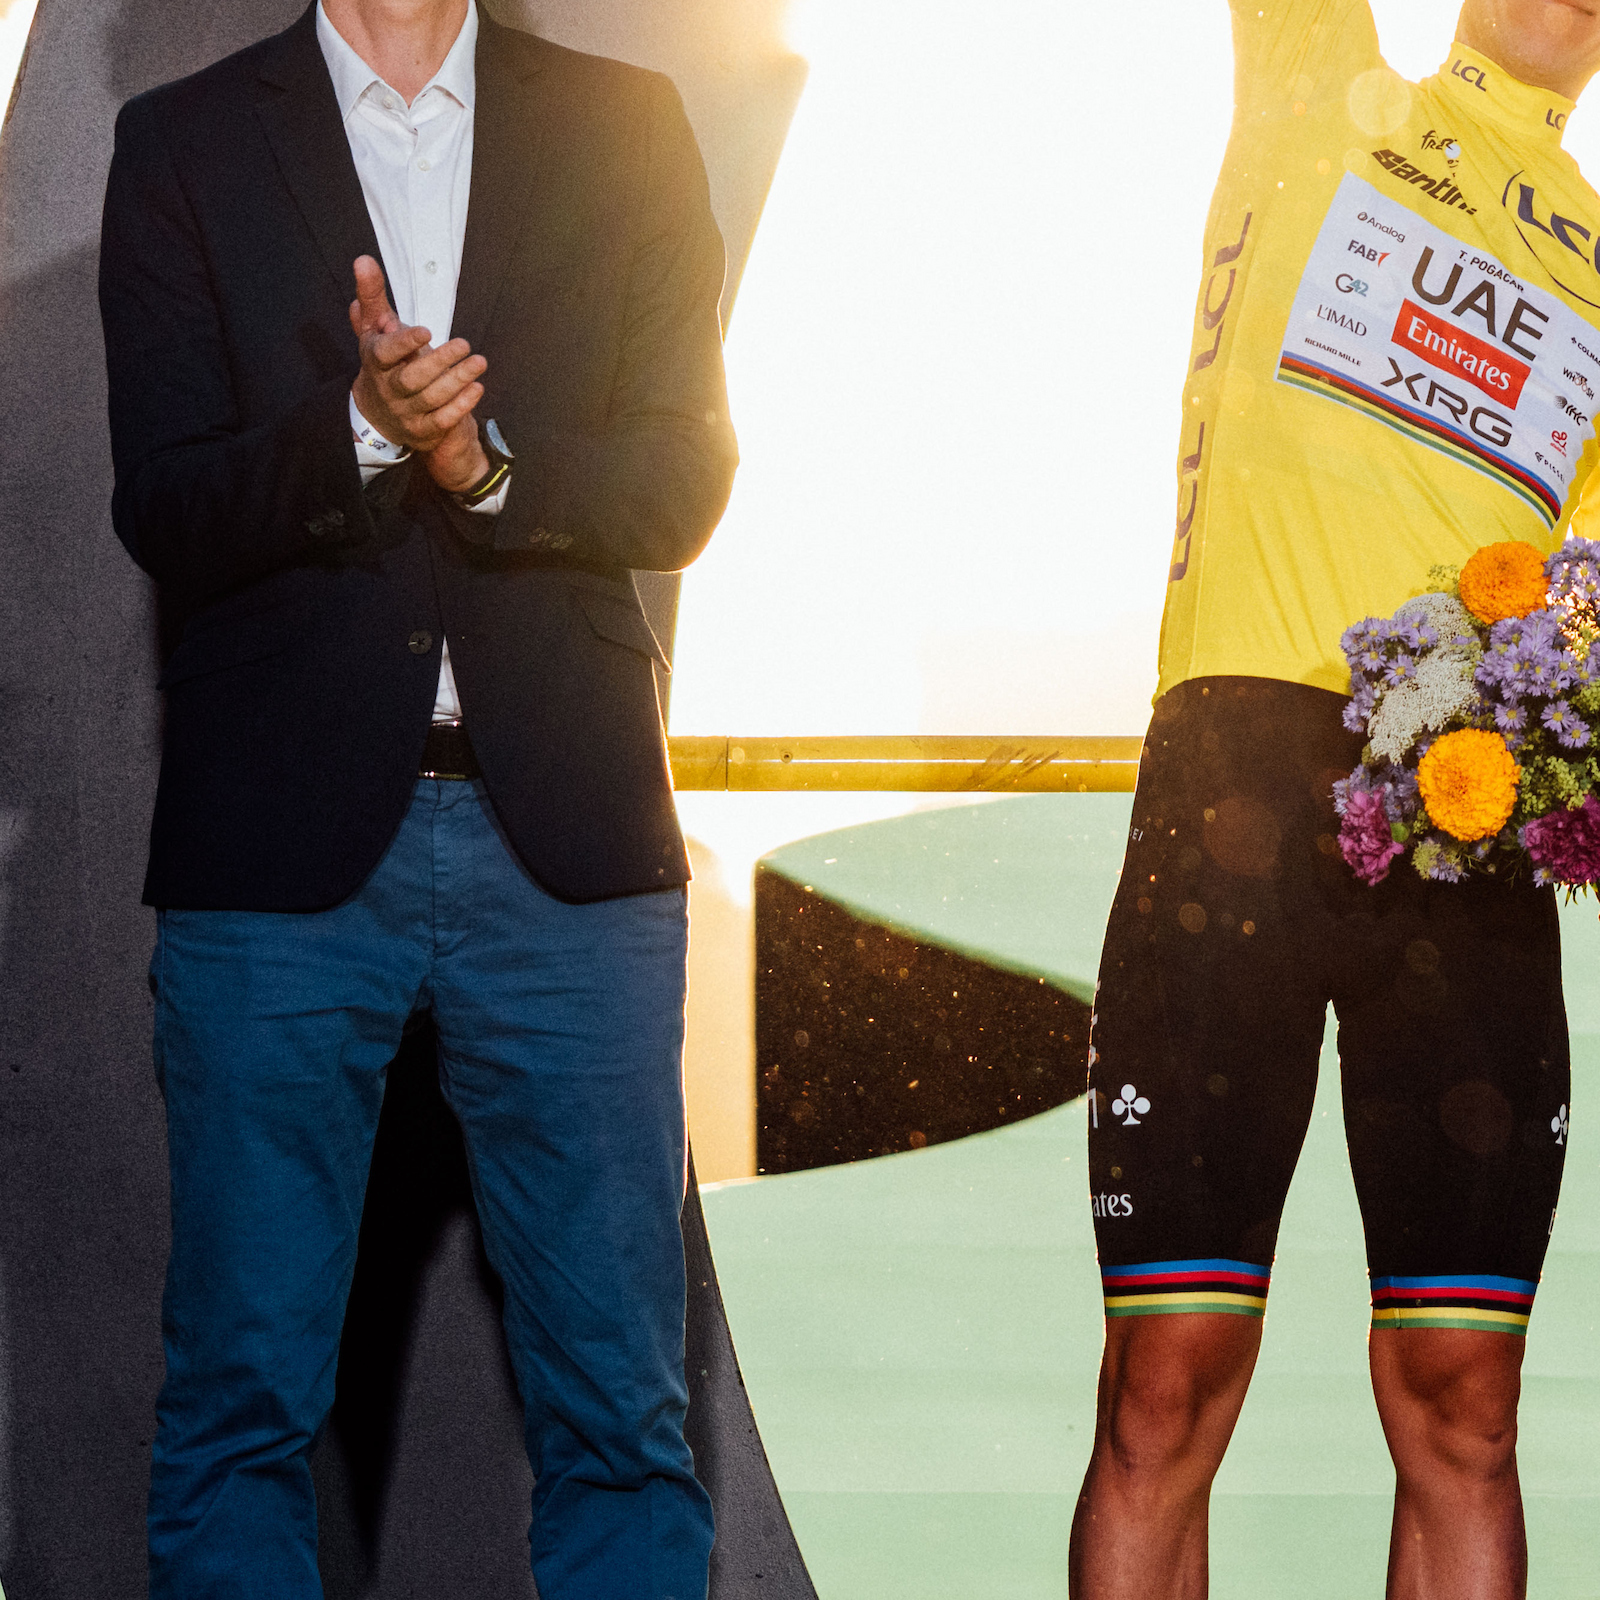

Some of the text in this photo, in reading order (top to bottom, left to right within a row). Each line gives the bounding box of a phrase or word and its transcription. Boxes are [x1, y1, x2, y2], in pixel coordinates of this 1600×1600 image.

[1451, 59, 1487, 92] LCL
[1545, 108, 1566, 130] LC
[1367, 217, 1406, 243] Analog
[1347, 240, 1378, 262] FAB
[1459, 250, 1467, 262] T.
[1194, 212, 1253, 373] LCL
[1335, 273, 1369, 297] G42
[1411, 246, 1550, 361] UAE
[1305, 337, 1362, 366] RICHARD MILLE
[1407, 316, 1511, 390] Emirates
[1380, 356, 1513, 447] XRG
